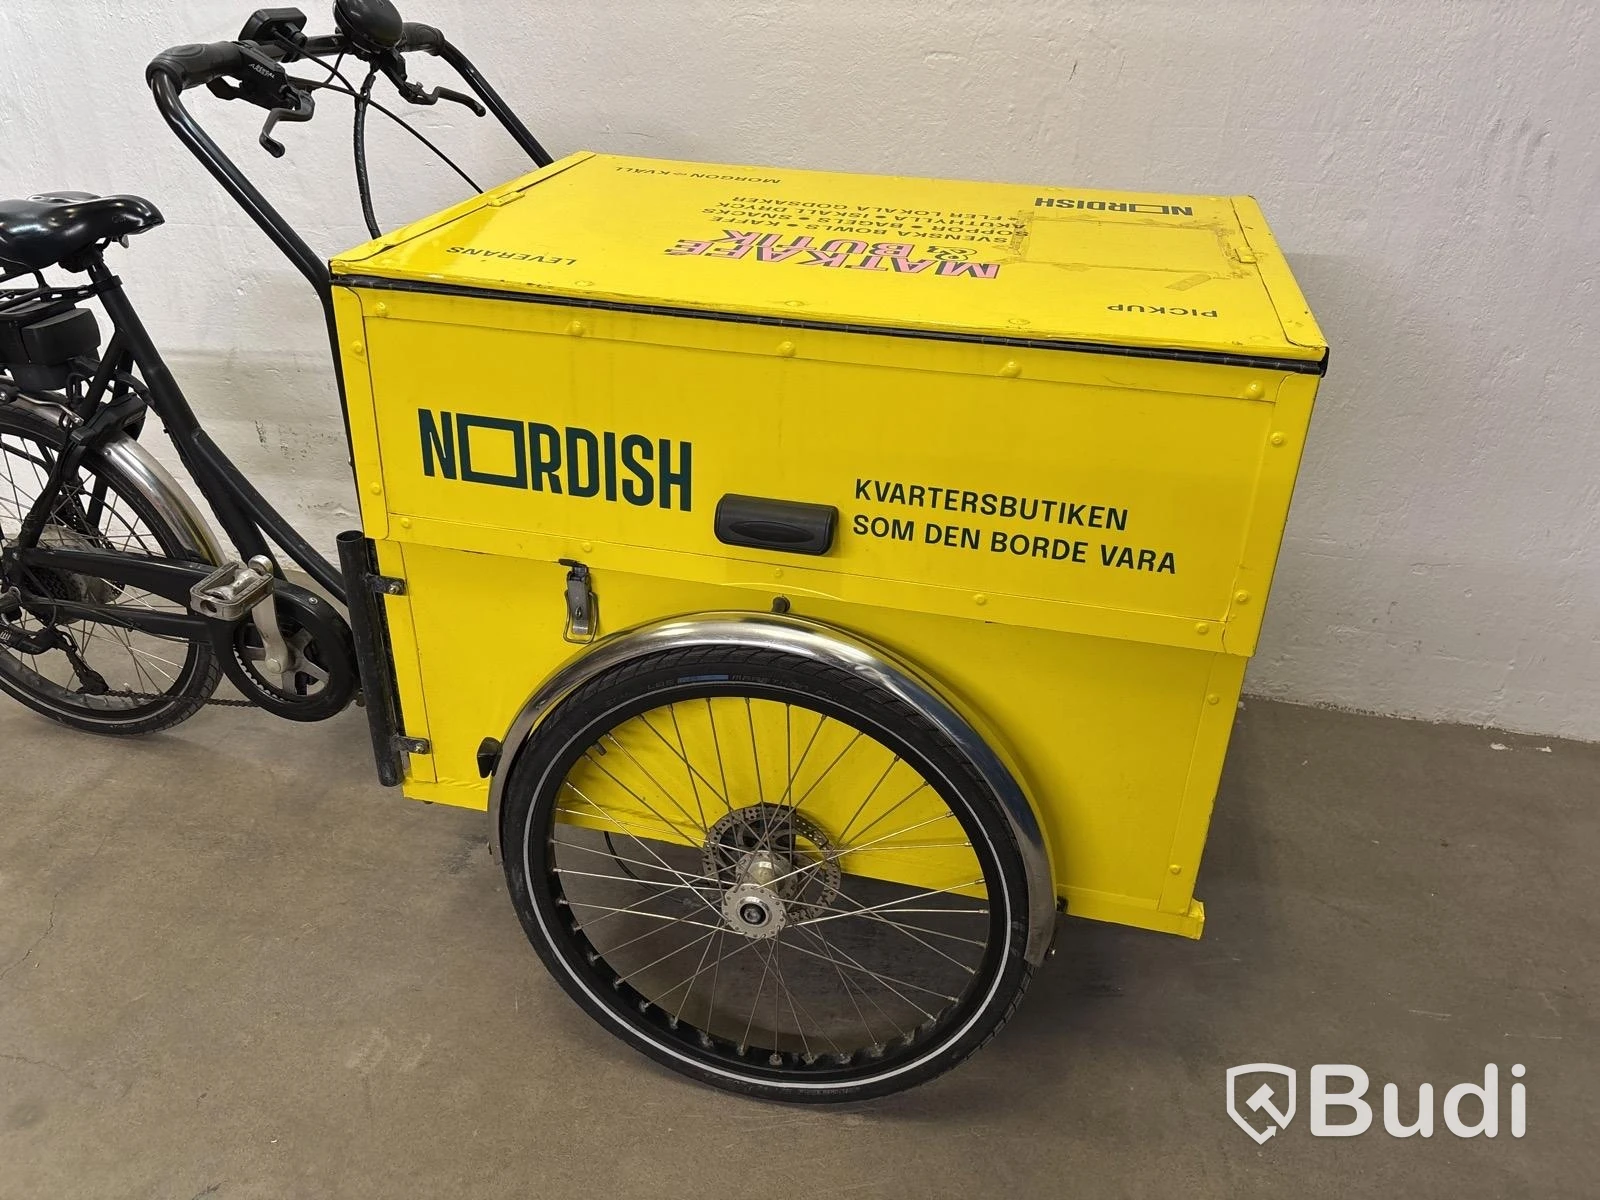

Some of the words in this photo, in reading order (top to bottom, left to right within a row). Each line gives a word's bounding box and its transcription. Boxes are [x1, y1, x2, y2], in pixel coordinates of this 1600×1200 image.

[715, 202, 789, 213] DRYCK
[731, 196, 848, 210] GODSAKER
[1034, 197, 1194, 217] NORDISH
[701, 208, 793, 220] SNACKS
[794, 207, 870, 219] ISKALL
[857, 206, 941, 216] LOKALA
[949, 213, 1002, 221] FLER
[709, 215, 781, 227] KAFFE
[817, 217, 903, 229] BAGELS
[895, 216, 1026, 229] AKUTHYLLA
[805, 223, 887, 235] BOWLS
[931, 225, 1029, 237] SOPPOR
[898, 231, 1008, 243] SVENSKA
[709, 229, 915, 259] BUTIK
[445, 246, 577, 266] LEVERANS
[1106, 304, 1219, 318] PICKUP
[417, 408, 692, 512] NORDISH
[854, 478, 1129, 531] KVARTERSBUTIKEN
[853, 514, 914, 541] SOM
[924, 523, 981, 550] DEN
[990, 531, 1089, 563] BORDE
[1099, 544, 1177, 574] VARA
